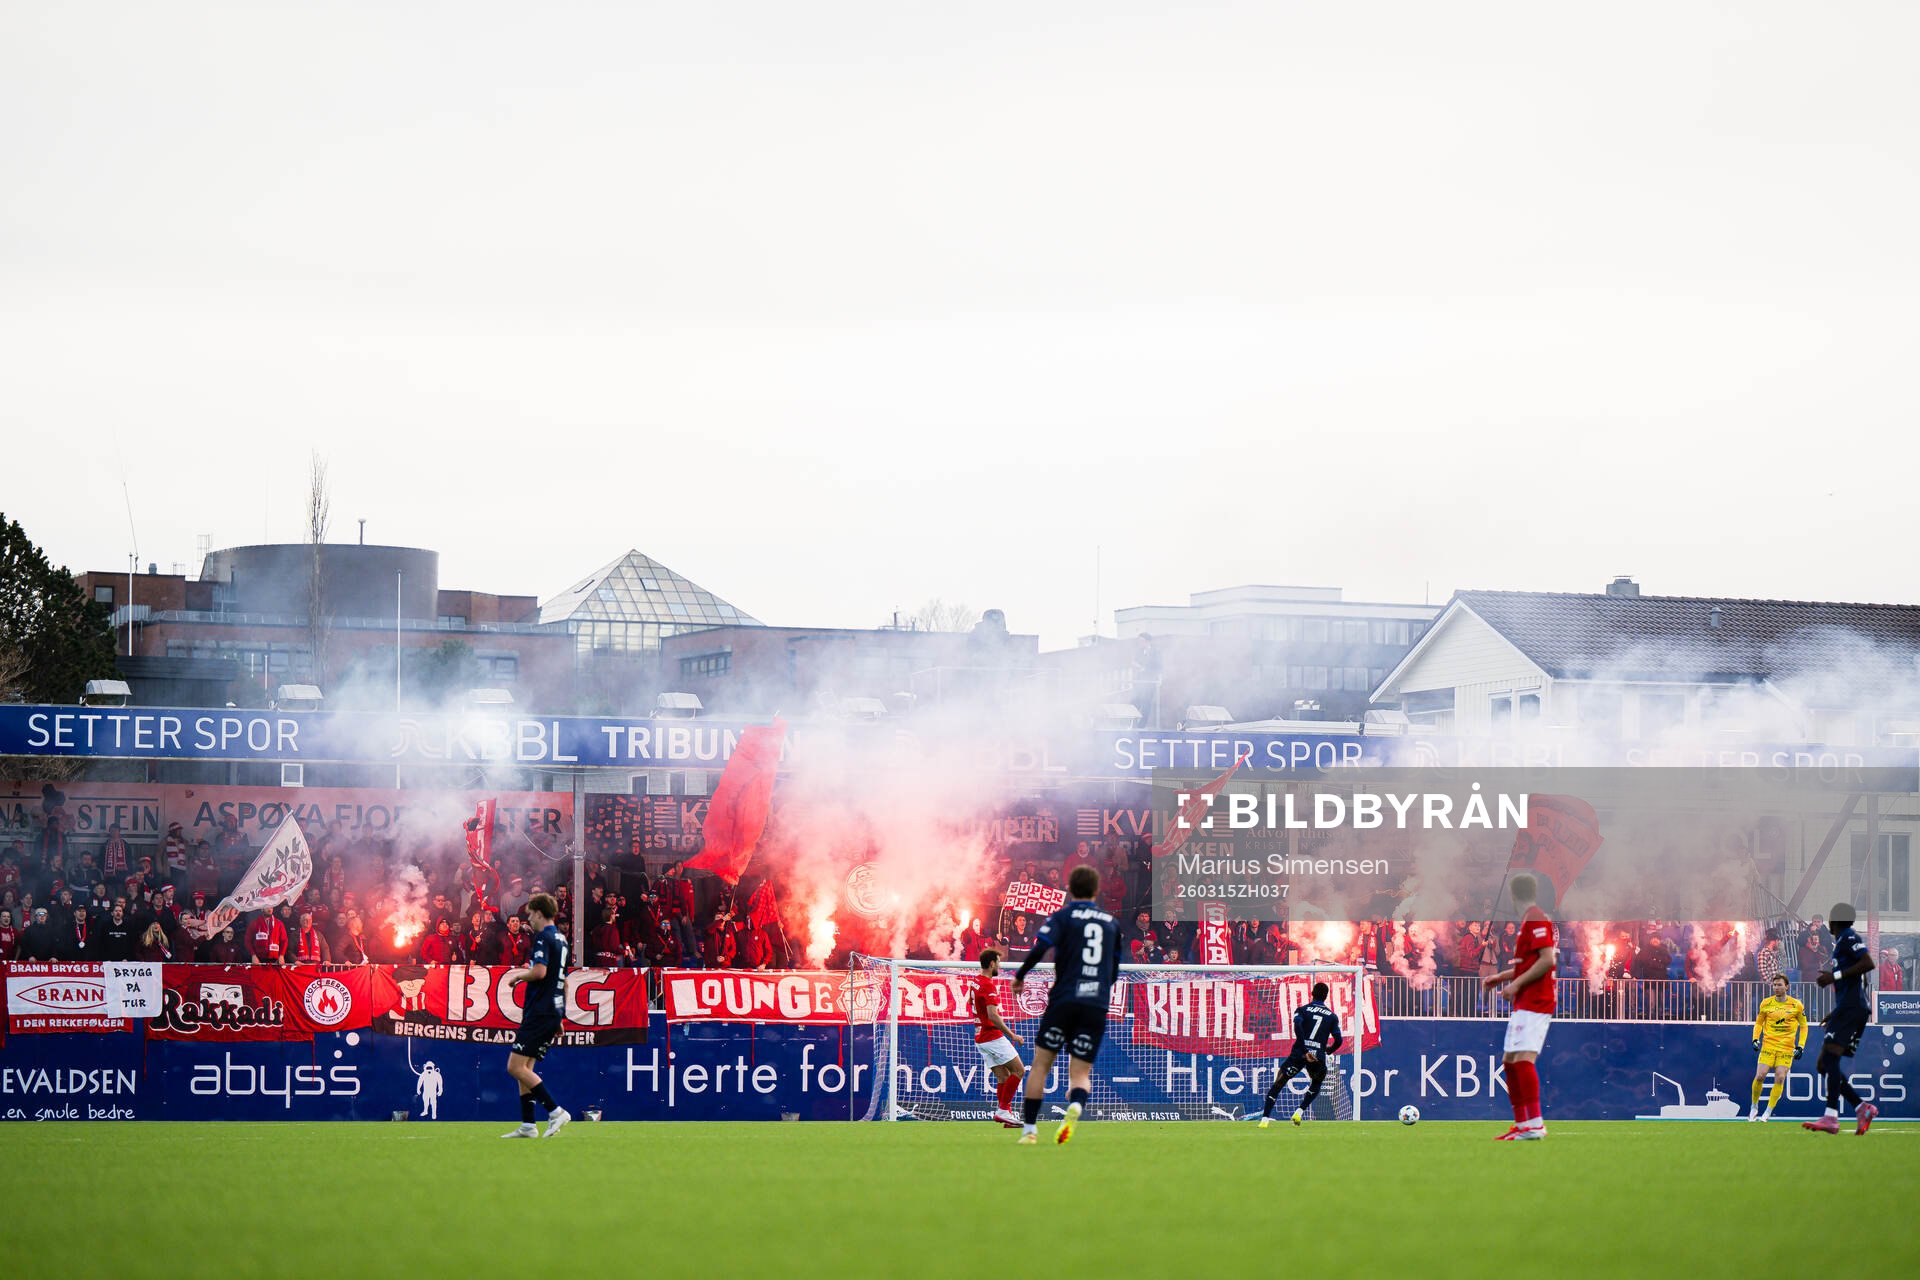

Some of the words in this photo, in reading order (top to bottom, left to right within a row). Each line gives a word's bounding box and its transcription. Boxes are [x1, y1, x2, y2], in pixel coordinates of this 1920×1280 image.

[28, 713, 182, 750] SETTER
[195, 717, 300, 752] SPOR
[1114, 738, 1255, 771] SETTER
[1266, 741, 1363, 774] SPOR
[77, 803, 160, 832] STEIN
[1009, 883, 1064, 903] SUPER
[1082, 923, 1103, 965] 3
[10, 964, 49, 974] BRANN
[52, 964, 89, 974] BRYGG
[114, 967, 153, 978] BRYGG
[37, 988, 104, 1002] BRANN
[122, 998, 147, 1009] TUR
[671, 976, 833, 1018] LOUNGE
[24, 1019, 46, 1028] DEN
[49, 1019, 125, 1028] REKKEFØLGEN
[150, 988, 284, 1033] Rakkadi
[1147, 981, 1255, 1040] BATAL
[394, 1021, 467, 1041] BERGENS
[1313, 1015, 1323, 1040] 7
[2, 1068, 136, 1095] EVALDSEN
[191, 1052, 361, 1109] abyss
[626, 1047, 777, 1107] Hjerte
[800, 1043, 869, 1092] for
[1420, 1054, 1509, 1098] KBK
[35, 1103, 80, 1122] smule
[88, 1103, 136, 1120] bedre
